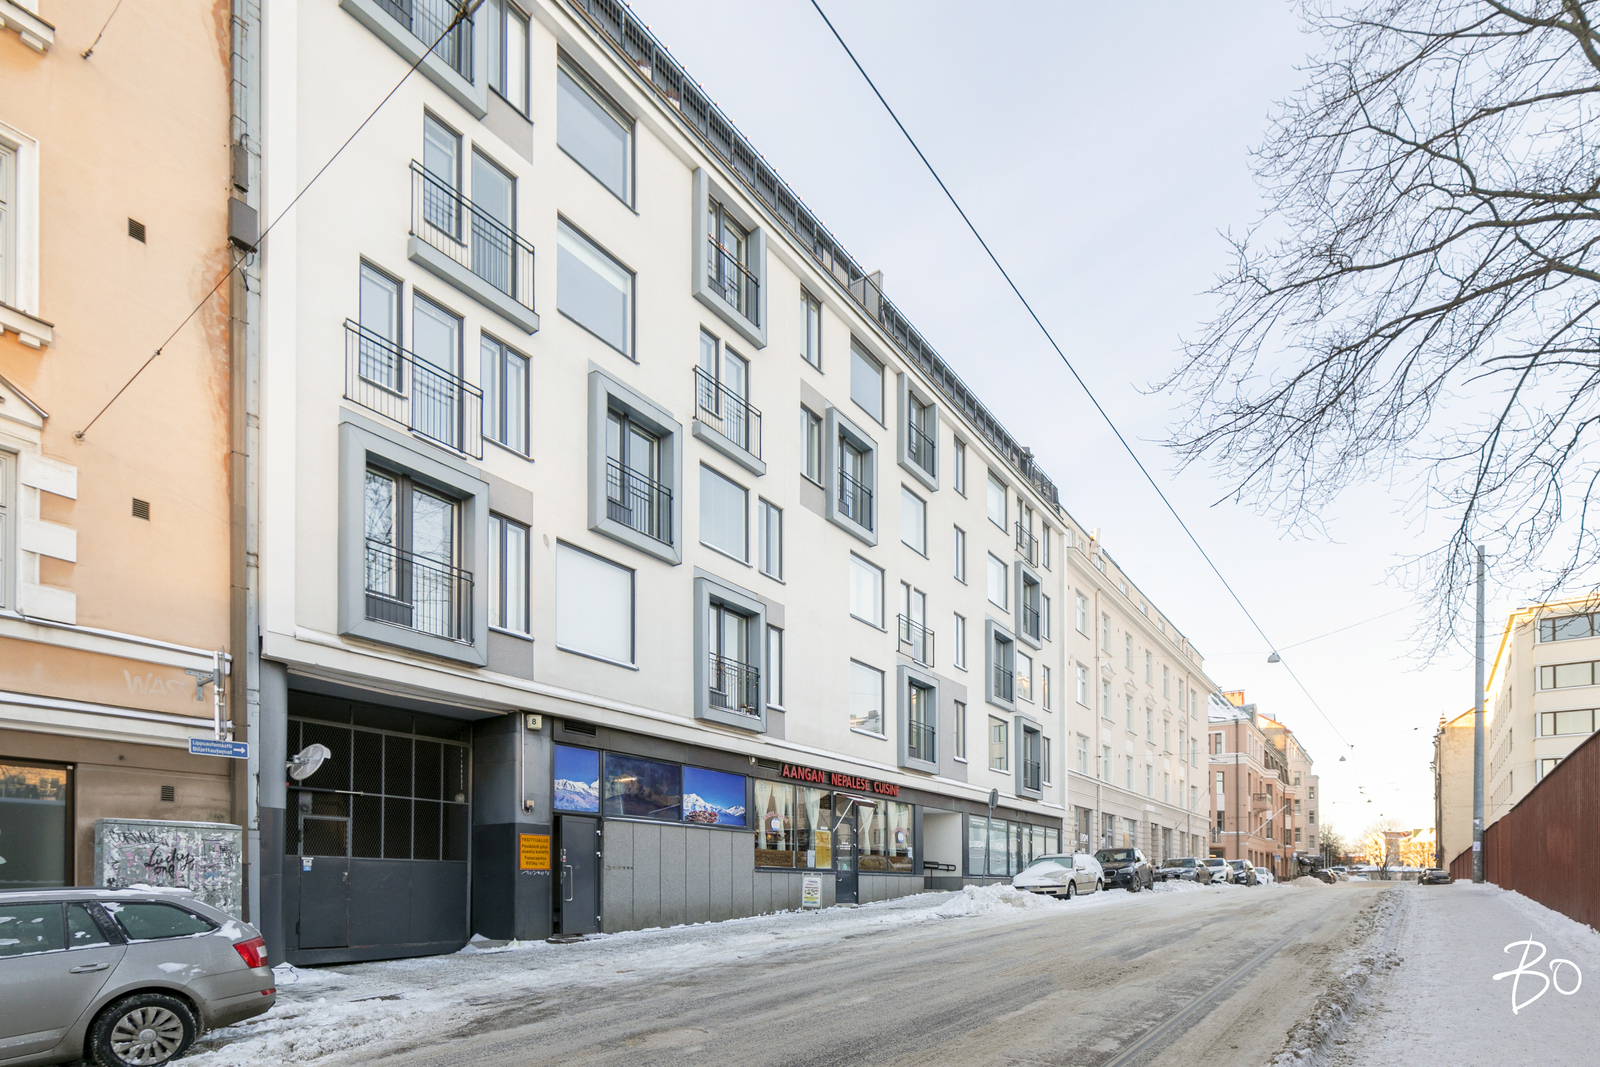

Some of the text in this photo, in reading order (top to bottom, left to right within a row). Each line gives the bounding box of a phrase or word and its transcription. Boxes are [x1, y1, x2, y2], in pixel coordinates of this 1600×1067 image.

[192, 740, 233, 748] Lippuautomaatti
[192, 746, 233, 755] Biljettautomat
[782, 763, 901, 797] AANGAN NEPALESE CUISINE
